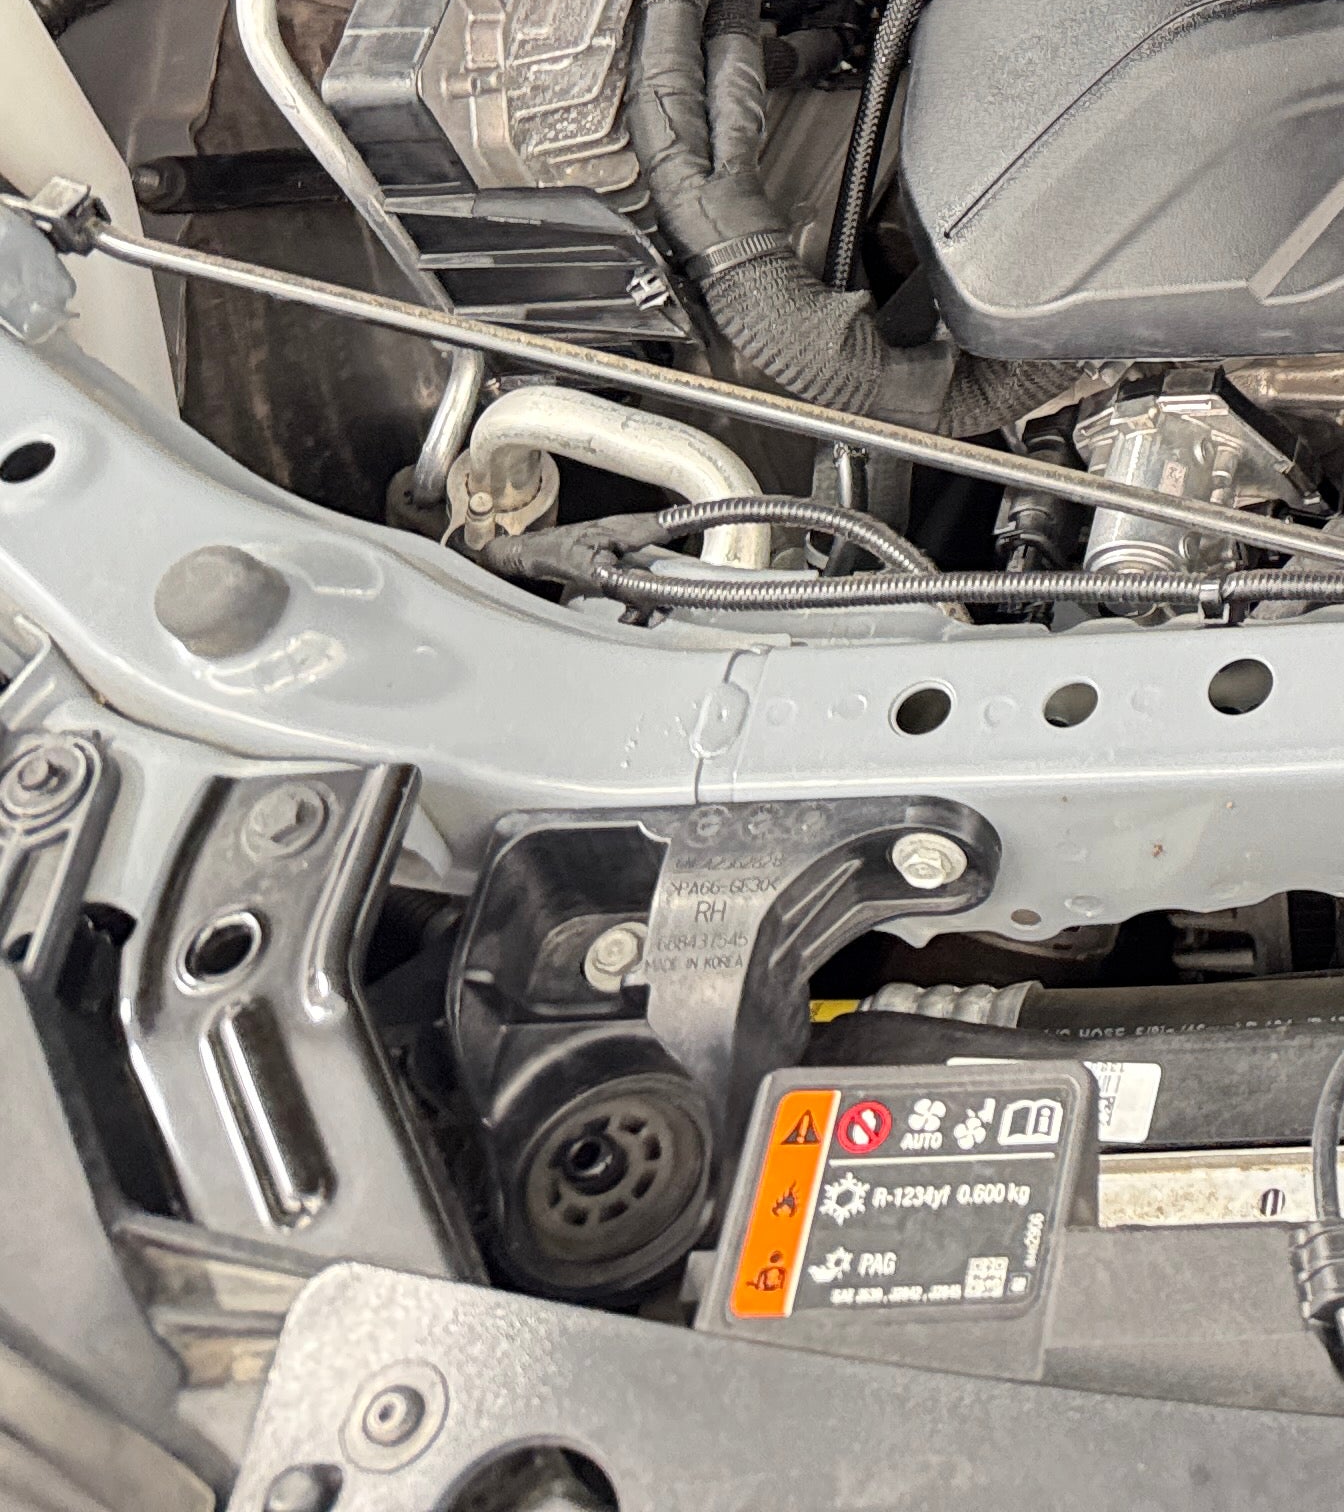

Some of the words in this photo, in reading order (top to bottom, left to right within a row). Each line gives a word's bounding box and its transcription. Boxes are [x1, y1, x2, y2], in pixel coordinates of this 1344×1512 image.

[695, 899, 728, 923] RH
[900, 1131, 943, 1152] AUTO
[871, 1184, 951, 1210] R-1234yf
[955, 1182, 1006, 1206] 0.600
[1007, 1182, 1031, 1207] kg
[857, 1251, 898, 1277] PAG
